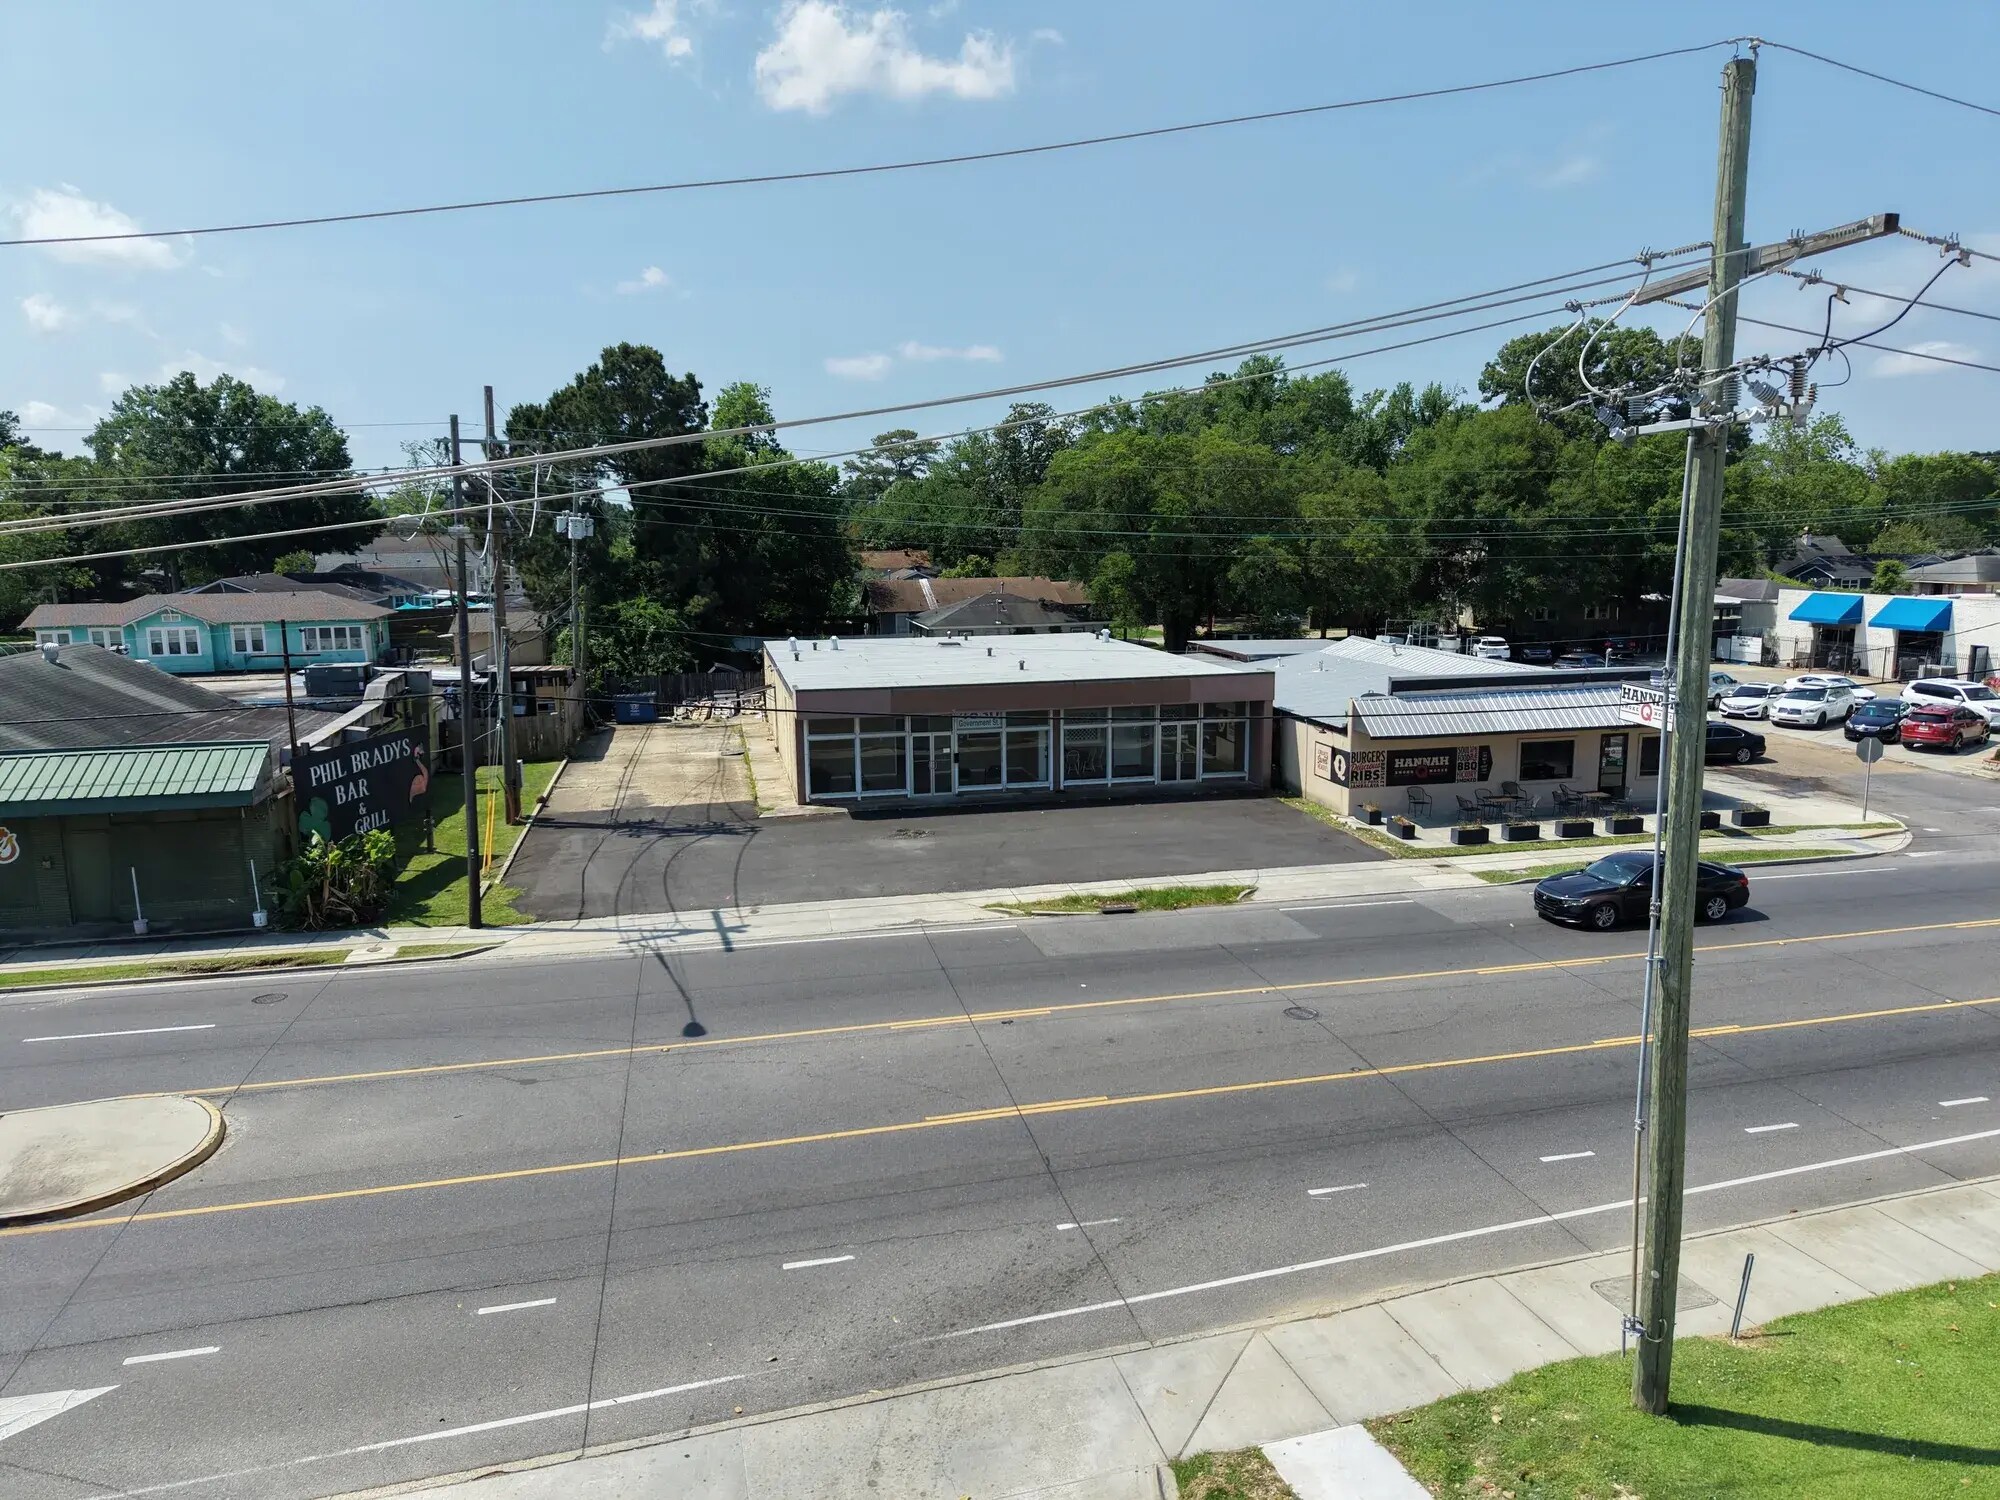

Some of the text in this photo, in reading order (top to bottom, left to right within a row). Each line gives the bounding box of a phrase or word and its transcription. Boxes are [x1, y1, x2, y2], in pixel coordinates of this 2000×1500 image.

[1641, 704, 1652, 721] Q
[959, 719, 992, 728] Government
[1351, 751, 1386, 763] BURGERS
[1394, 756, 1450, 768] HANNAH
[1458, 761, 1478, 771] BBQ
[310, 759, 347, 787] PHIL
[1351, 770, 1380, 782] RIBS
[335, 779, 370, 805] BAR
[359, 802, 367, 815] &
[355, 809, 390, 834] GRILL
